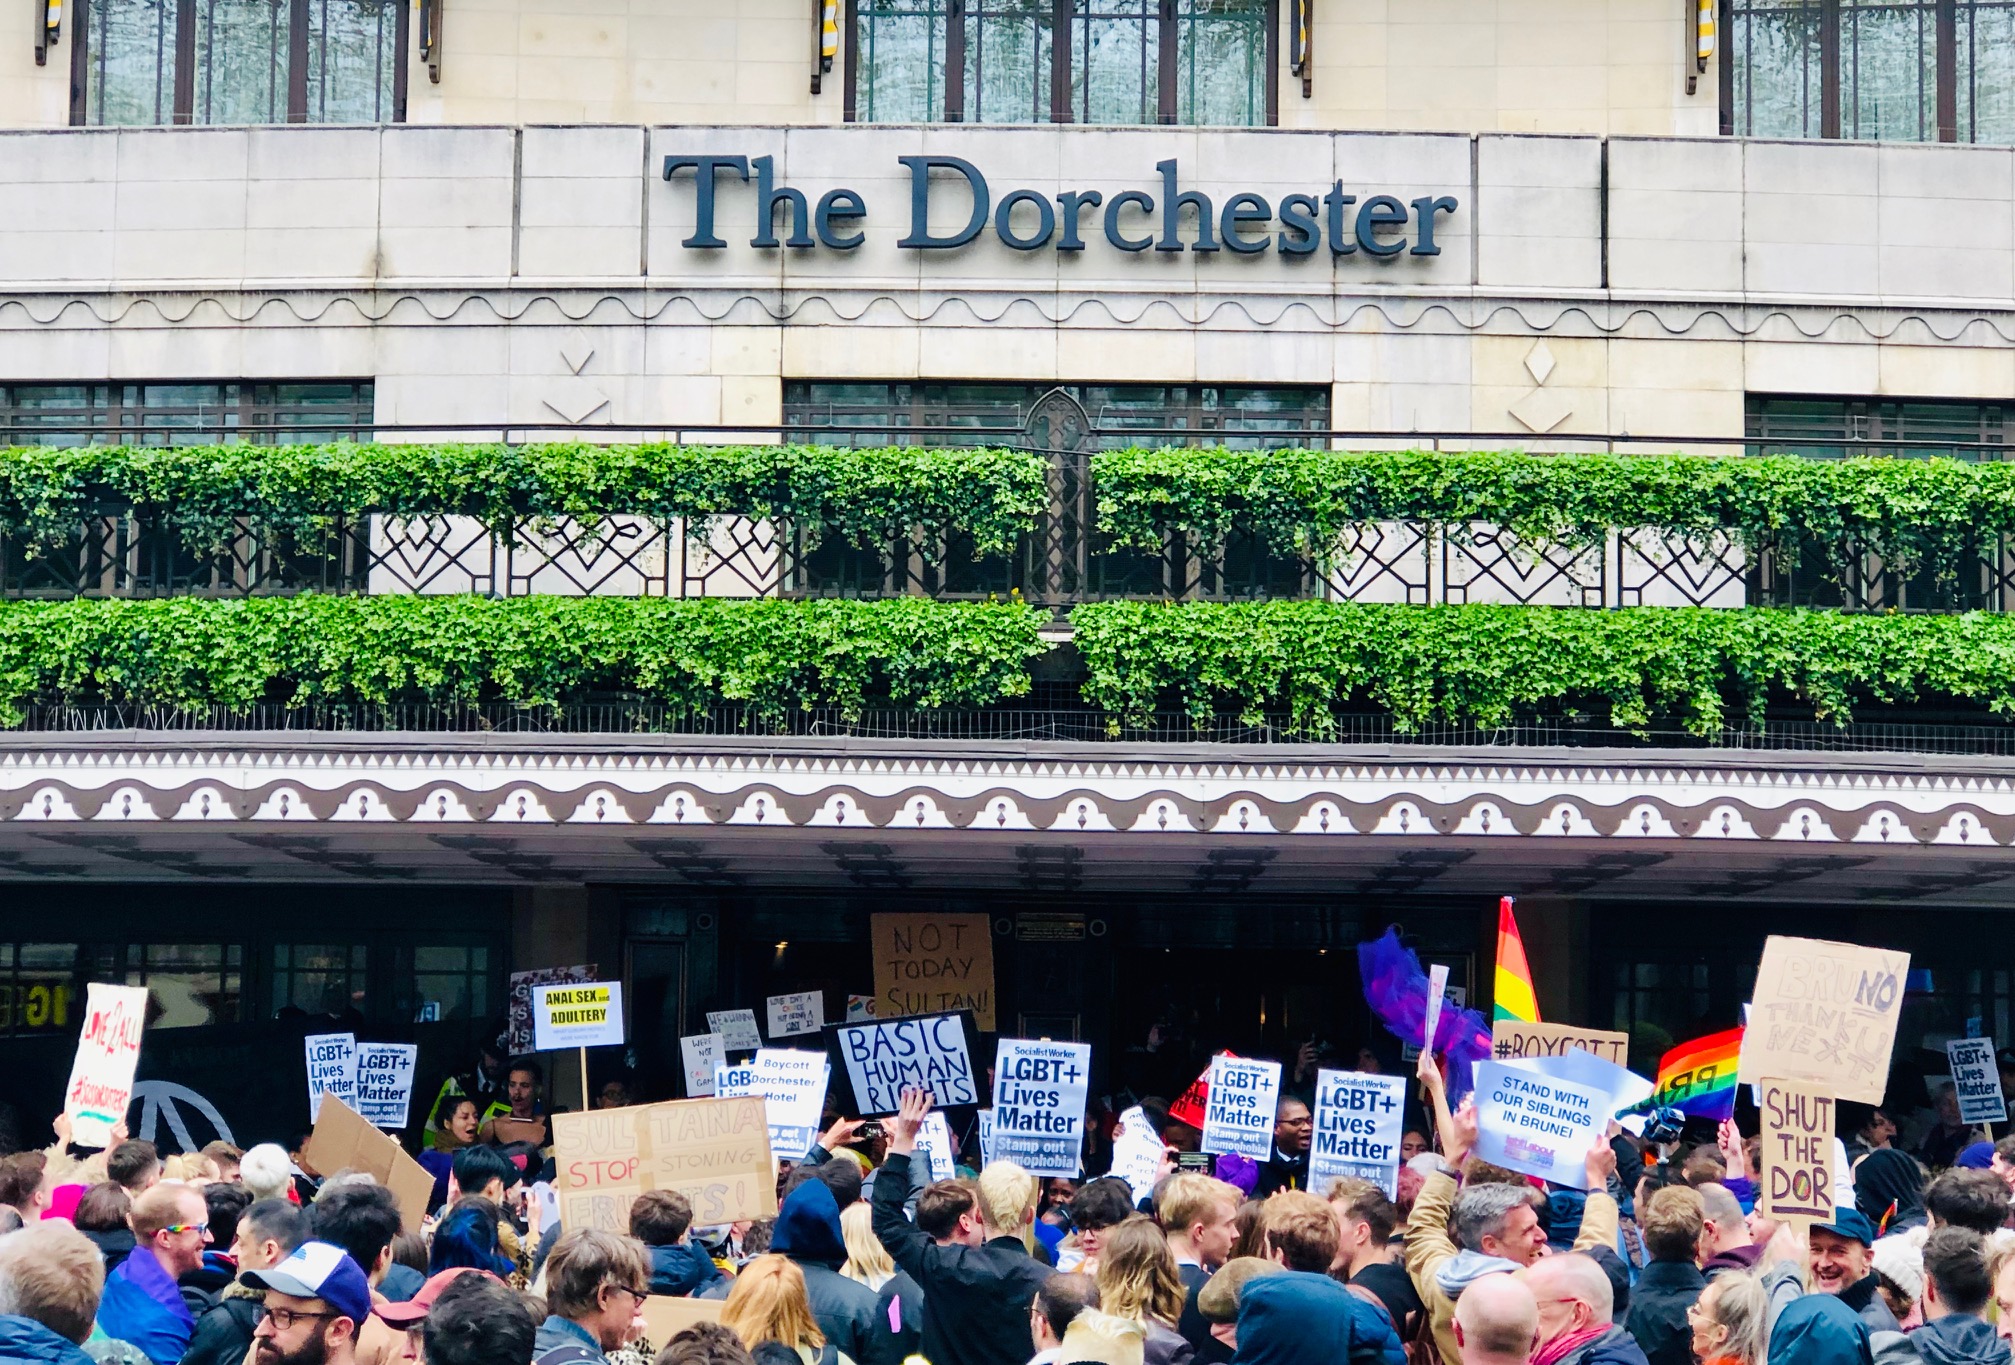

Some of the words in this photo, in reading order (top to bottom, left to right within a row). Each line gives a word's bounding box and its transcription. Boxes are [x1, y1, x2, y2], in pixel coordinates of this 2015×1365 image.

[663, 154, 869, 251] The
[897, 154, 1458, 257] Dorchester
[893, 923, 968, 954] NOT
[888, 956, 974, 981] TODAY
[546, 991, 574, 1006] ANAL
[576, 989, 597, 1004] SEX
[551, 1008, 607, 1025] ADULTERY
[847, 1017, 957, 1062] BASIC
[309, 1044, 352, 1063] LGBT+
[699, 1047, 712, 1057] NOT
[1014, 1045, 1048, 1057] Socialist
[1048, 1047, 1076, 1059] Worker
[1766, 1024, 1876, 1081] NEXT
[1949, 1048, 1991, 1067] LGBT+
[310, 1063, 344, 1079] Lives
[357, 1054, 411, 1070] LGBT+
[763, 1058, 810, 1071] Boycott
[863, 1052, 968, 1086] HUMAN
[1001, 1056, 1081, 1084] LGBT+
[1224, 1061, 1249, 1071] Socialist
[1249, 1063, 1270, 1073] Worker
[356, 1069, 396, 1086] Lives
[718, 1070, 754, 1088] LGB
[751, 1074, 816, 1087] Dorchester
[1213, 1068, 1273, 1092] LGBT+
[1333, 1076, 1365, 1087] Socialist
[1365, 1078, 1392, 1090] Worker
[1953, 1066, 1985, 1082] Lives
[311, 1079, 354, 1096] Matter
[356, 1084, 407, 1101] Matter
[765, 1091, 797, 1102] Hotel
[998, 1081, 1060, 1108] Lives
[1502, 1076, 1551, 1098] STAND
[1554, 1089, 1590, 1109] WITH
[1957, 1081, 1997, 1097] Matter
[1211, 1087, 1257, 1109] Lives
[1320, 1085, 1397, 1114] LGBT+
[382, 1104, 398, 1112] out
[1208, 1105, 1270, 1128] Matter
[1492, 1090, 1524, 1108] OUR
[1526, 1099, 1592, 1127] SIBLINGS
[1766, 1087, 1833, 1133] SHUT
[996, 1106, 1077, 1134] Matter
[1318, 1108, 1376, 1135] Lives
[1502, 1110, 1517, 1123] IN
[1520, 1115, 1574, 1139] BRUNEI
[1208, 1126, 1240, 1142] Stamp
[1242, 1131, 1260, 1143] out
[997, 1137, 1039, 1155] Stamp
[1043, 1140, 1066, 1154] out
[1207, 1138, 1267, 1155] homophobia
[1316, 1132, 1393, 1160] Matter
[1777, 1133, 1824, 1166] THE
[569, 1157, 640, 1188] STOP
[660, 1148, 757, 1173] STONING
[1316, 1160, 1356, 1176] Stamp
[1360, 1166, 1382, 1179] out
[1771, 1165, 1832, 1208] DOR
